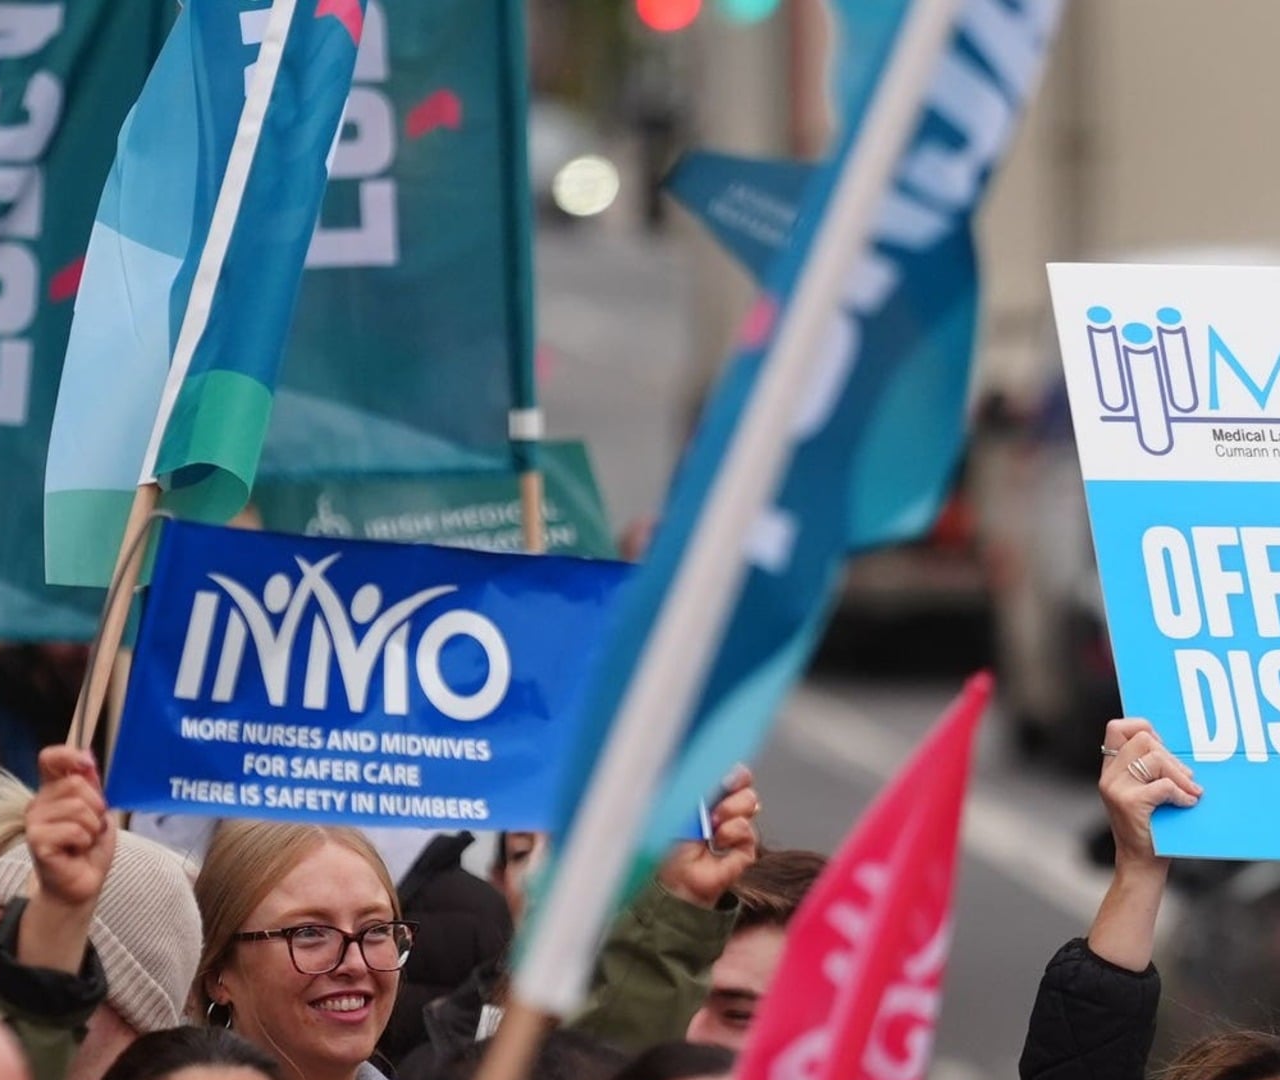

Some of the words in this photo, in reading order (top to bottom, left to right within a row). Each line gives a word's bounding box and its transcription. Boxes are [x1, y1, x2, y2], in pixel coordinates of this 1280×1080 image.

[1212, 428, 1266, 442] Medical
[1215, 444, 1269, 458] Cumann
[173, 552, 512, 722] INMO
[180, 716, 240, 743] MORE
[242, 721, 324, 750] NURSES
[326, 728, 378, 753] AND
[381, 732, 492, 762] MIDWIVES
[243, 752, 287, 777] FOR
[290, 756, 361, 783] SAFER
[363, 761, 421, 787] CARE
[170, 776, 237, 805] THERE
[240, 783, 262, 806] IS
[264, 785, 347, 812] SAFETY
[350, 792, 375, 814] IN
[378, 793, 490, 820] NUMBERS
